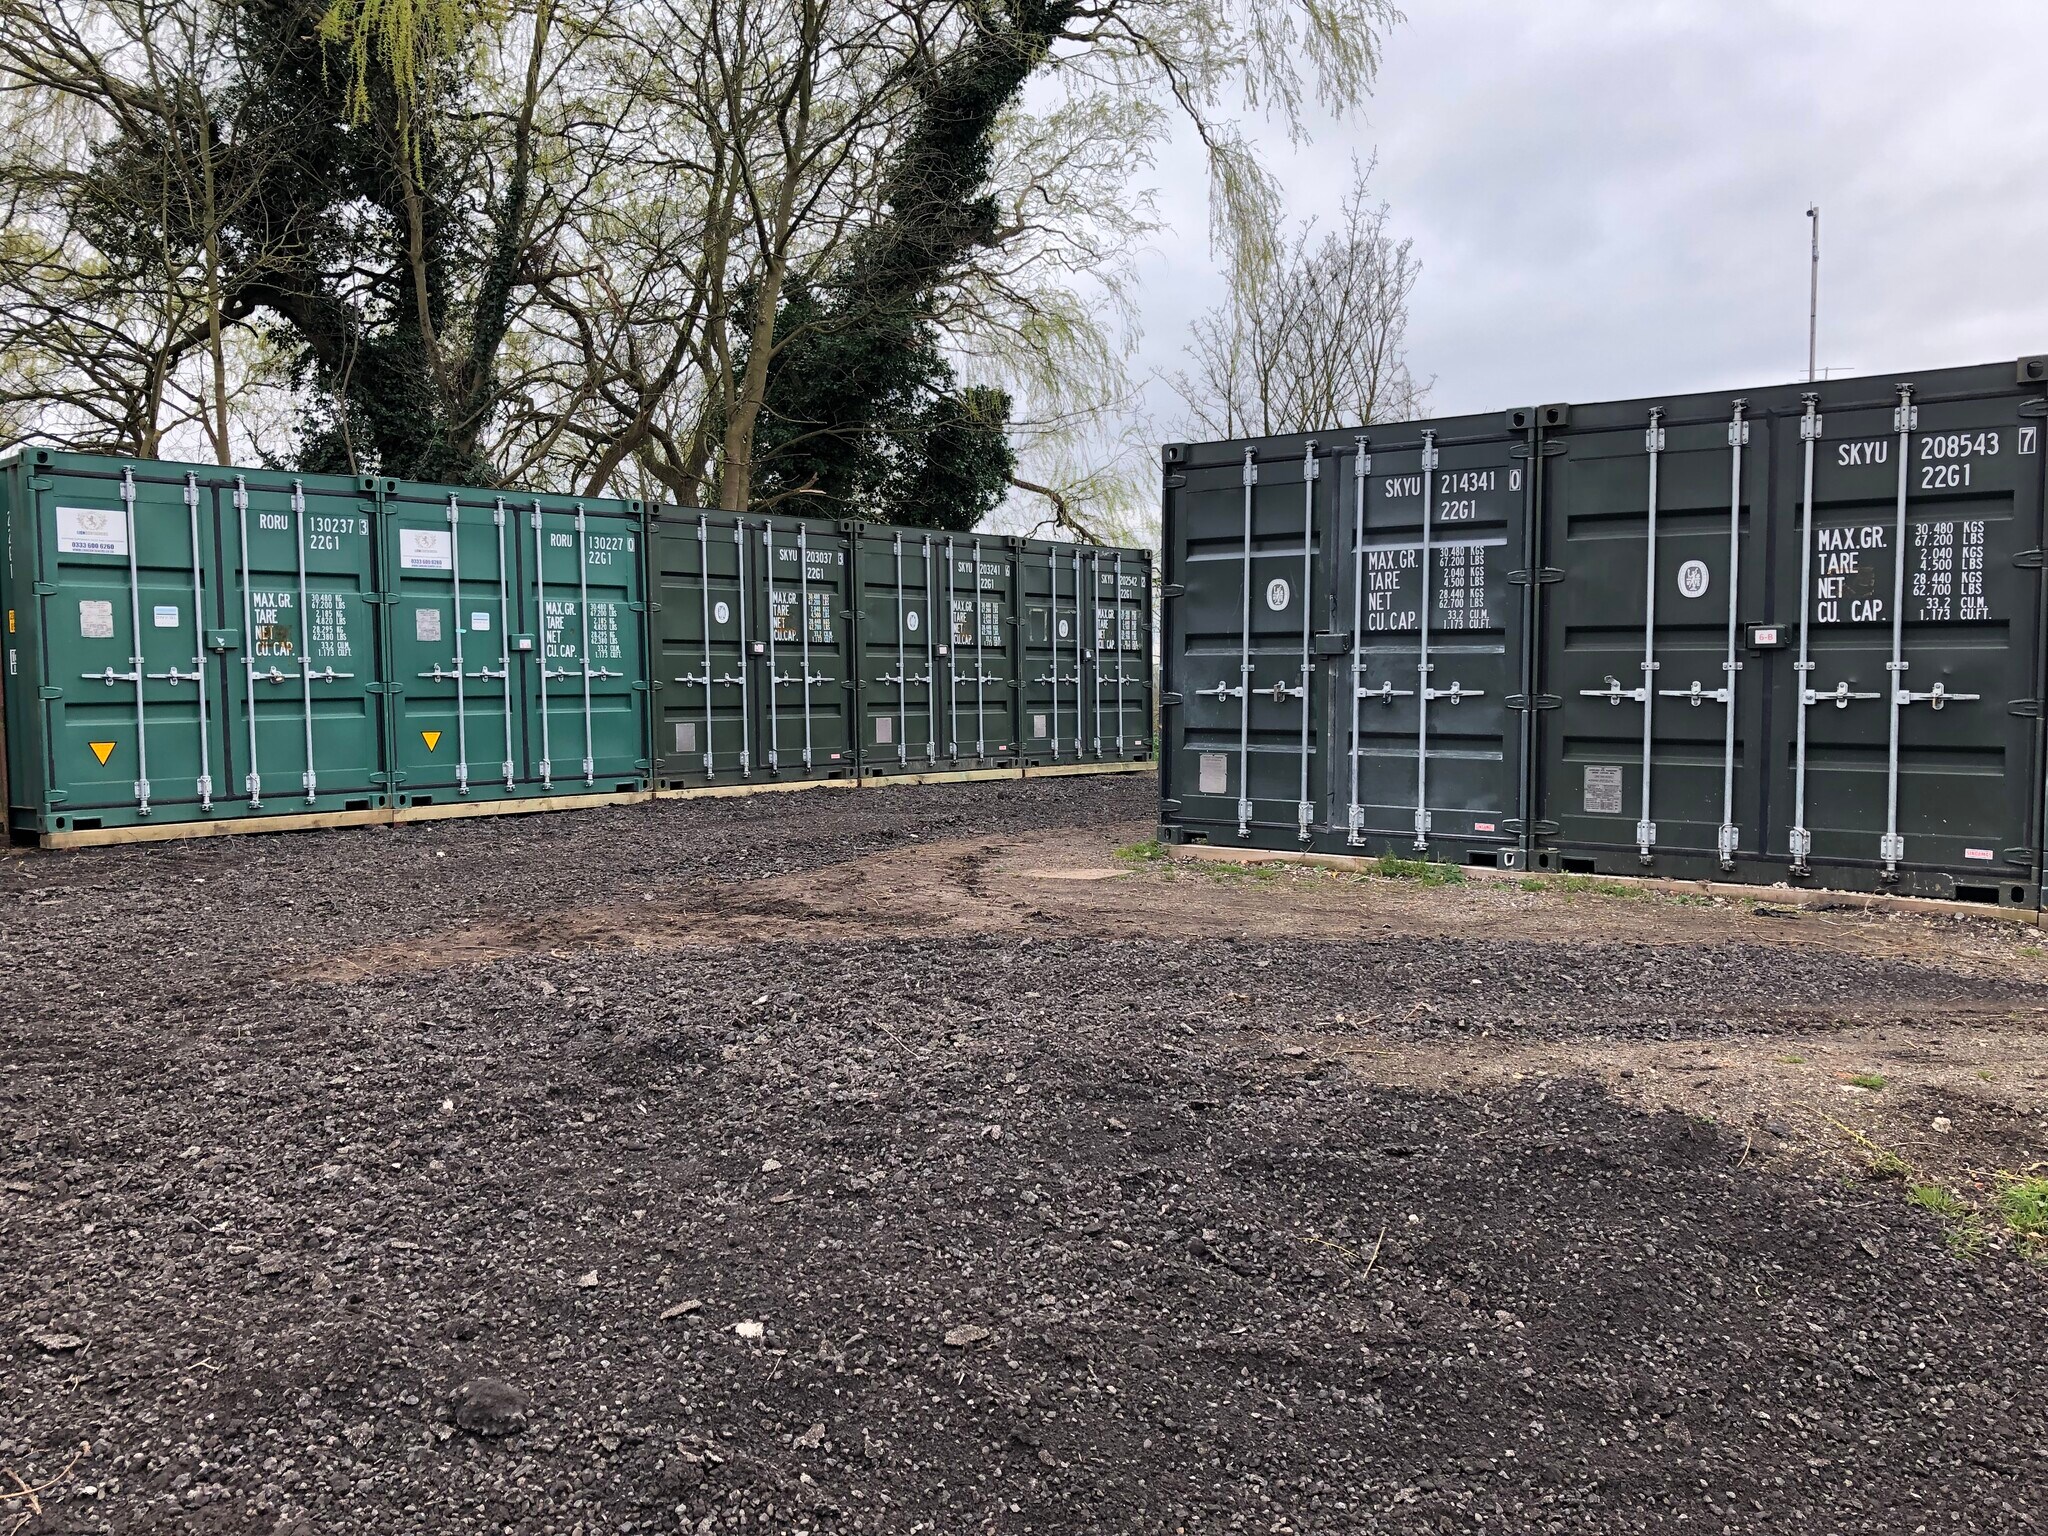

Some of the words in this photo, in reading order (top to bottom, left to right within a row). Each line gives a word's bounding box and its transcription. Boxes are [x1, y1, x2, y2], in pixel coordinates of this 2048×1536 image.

[1838, 441, 1887, 466] SKYU
[1921, 433, 1999, 459] 208543
[2019, 428, 2035, 453] 7
[1922, 464, 1970, 488] 22G1
[1386, 477, 1420, 498] SKYU
[1441, 471, 1494, 494] 214341
[1510, 469, 1520, 490] 0
[1441, 500, 1475, 520] 22G1
[260, 514, 288, 529] RORU
[310, 517, 354, 533] 130237
[360, 519, 368, 535] 3
[1964, 522, 1984, 532] KGS
[310, 535, 339, 550] 22G1
[551, 533, 572, 547] RORU
[589, 536, 623, 550] 130227
[1818, 526, 1887, 551] MAX.GR.
[1963, 533, 1983, 544] LBS
[780, 549, 797, 561] SKYU
[806, 551, 832, 564] 203037
[1471, 546, 1484, 555] KGS
[1962, 547, 1983, 558] KGS
[589, 552, 611, 564] 22G1
[1471, 556, 1484, 565] LBS
[1819, 552, 1858, 574] TARE
[1962, 558, 1983, 569] LBS
[808, 568, 823, 579] 22G1
[958, 562, 972, 573] SKYU
[980, 564, 1000, 575] 203241
[1470, 567, 1484, 576] KGS
[1101, 574, 1113, 584] SKYU
[1369, 571, 1400, 590] TARE
[1470, 577, 1484, 586] LBS
[1962, 572, 1982, 582] KGS
[981, 579, 994, 589] 22G1
[1818, 577, 1845, 599] NET
[1961, 583, 1982, 594] LBS
[1470, 588, 1484, 598] KGS
[253, 593, 293, 608] MAX.GR.
[1369, 592, 1392, 610] NET
[1470, 598, 1484, 607] LBS
[1927, 598, 1950, 609] 33.2
[255, 609, 278, 623] TARE
[773, 605, 789, 616] TARE
[1818, 601, 1840, 622] CU.
[1852, 600, 1886, 621] CAP.
[547, 616, 564, 629] TARE
[773, 617, 785, 628] NET
[953, 612, 967, 622] TARE
[255, 626, 273, 640] NET
[547, 630, 561, 643] NET
